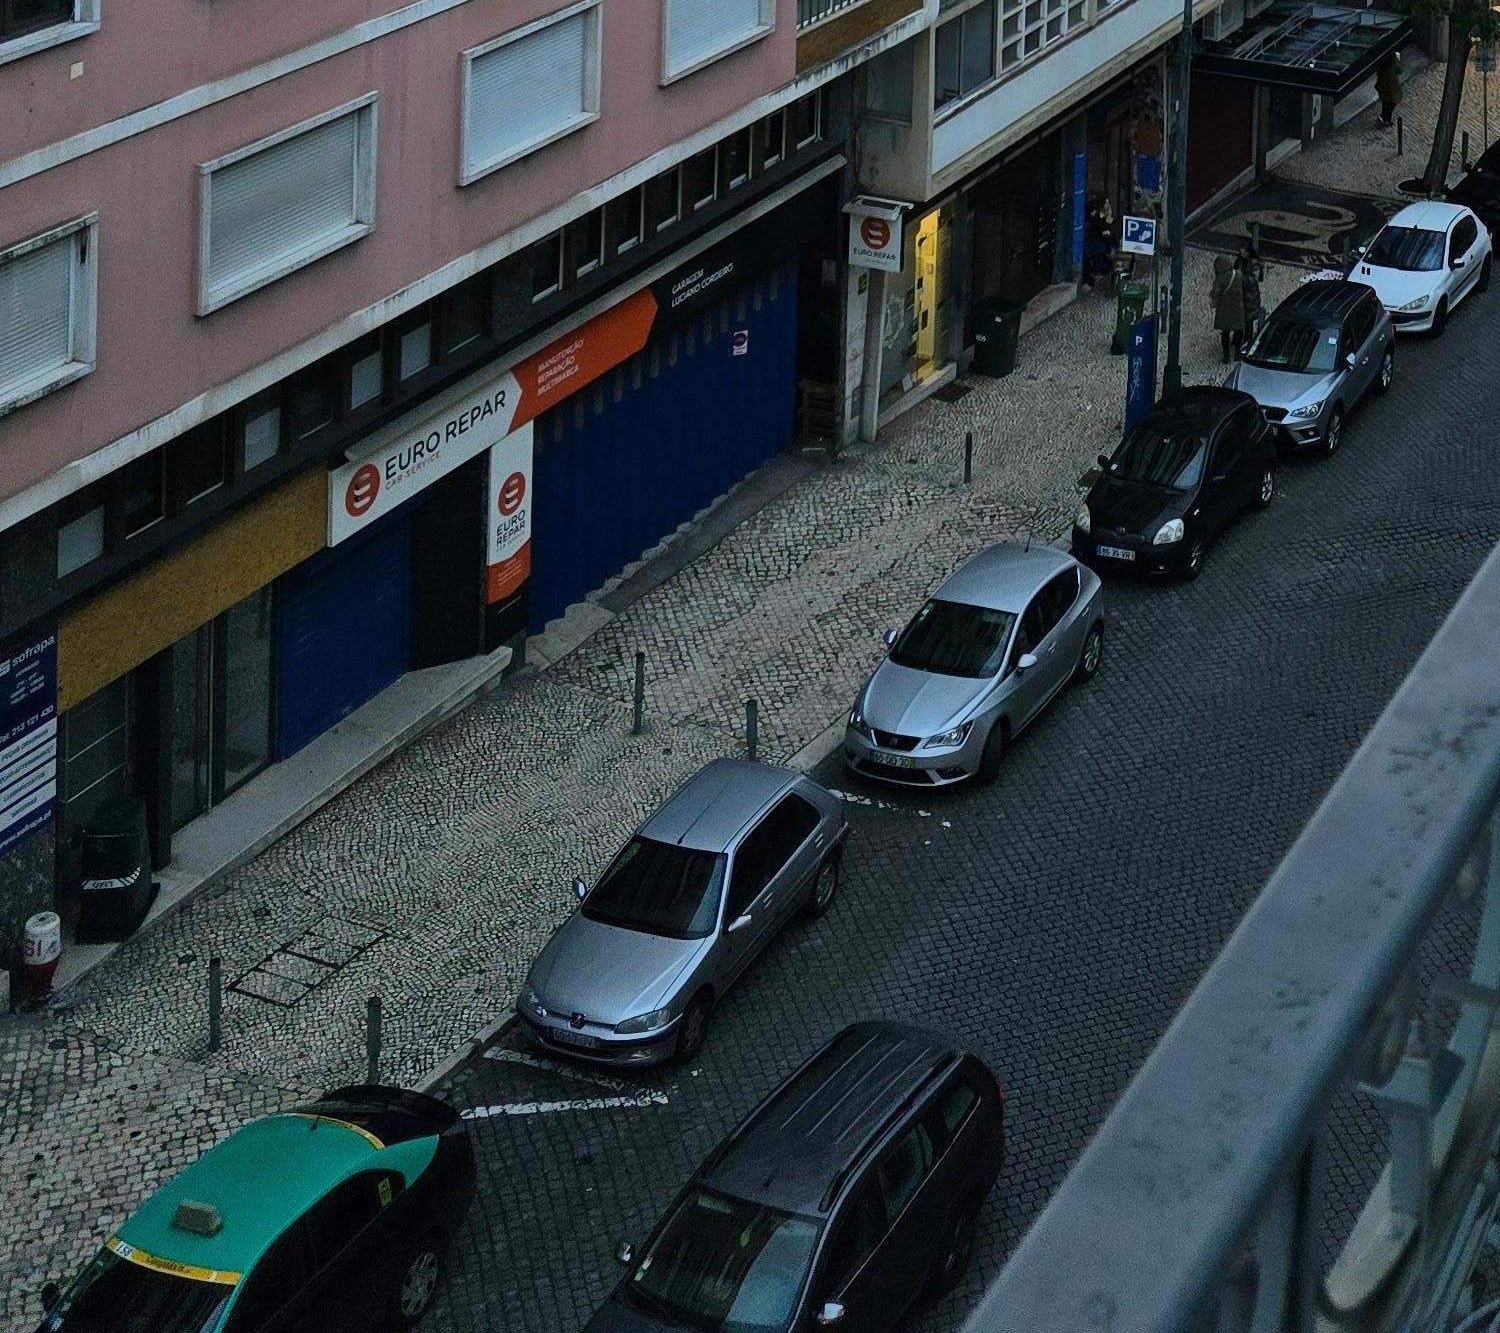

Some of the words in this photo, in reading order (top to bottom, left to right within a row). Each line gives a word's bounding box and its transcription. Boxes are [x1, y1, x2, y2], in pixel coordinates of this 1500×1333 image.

[1127, 220, 1140, 238] P
[671, 284, 701, 308] LUCIANO
[1135, 335, 1143, 346] P
[385, 431, 441, 481] EURO
[445, 390, 506, 444] REPAR
[385, 475, 403, 491] CAR
[406, 451, 441, 478] SERVICE
[496, 510, 526, 537] EURO
[496, 522, 526, 547] REPAR
[12, 635, 55, 667] sofrapa
